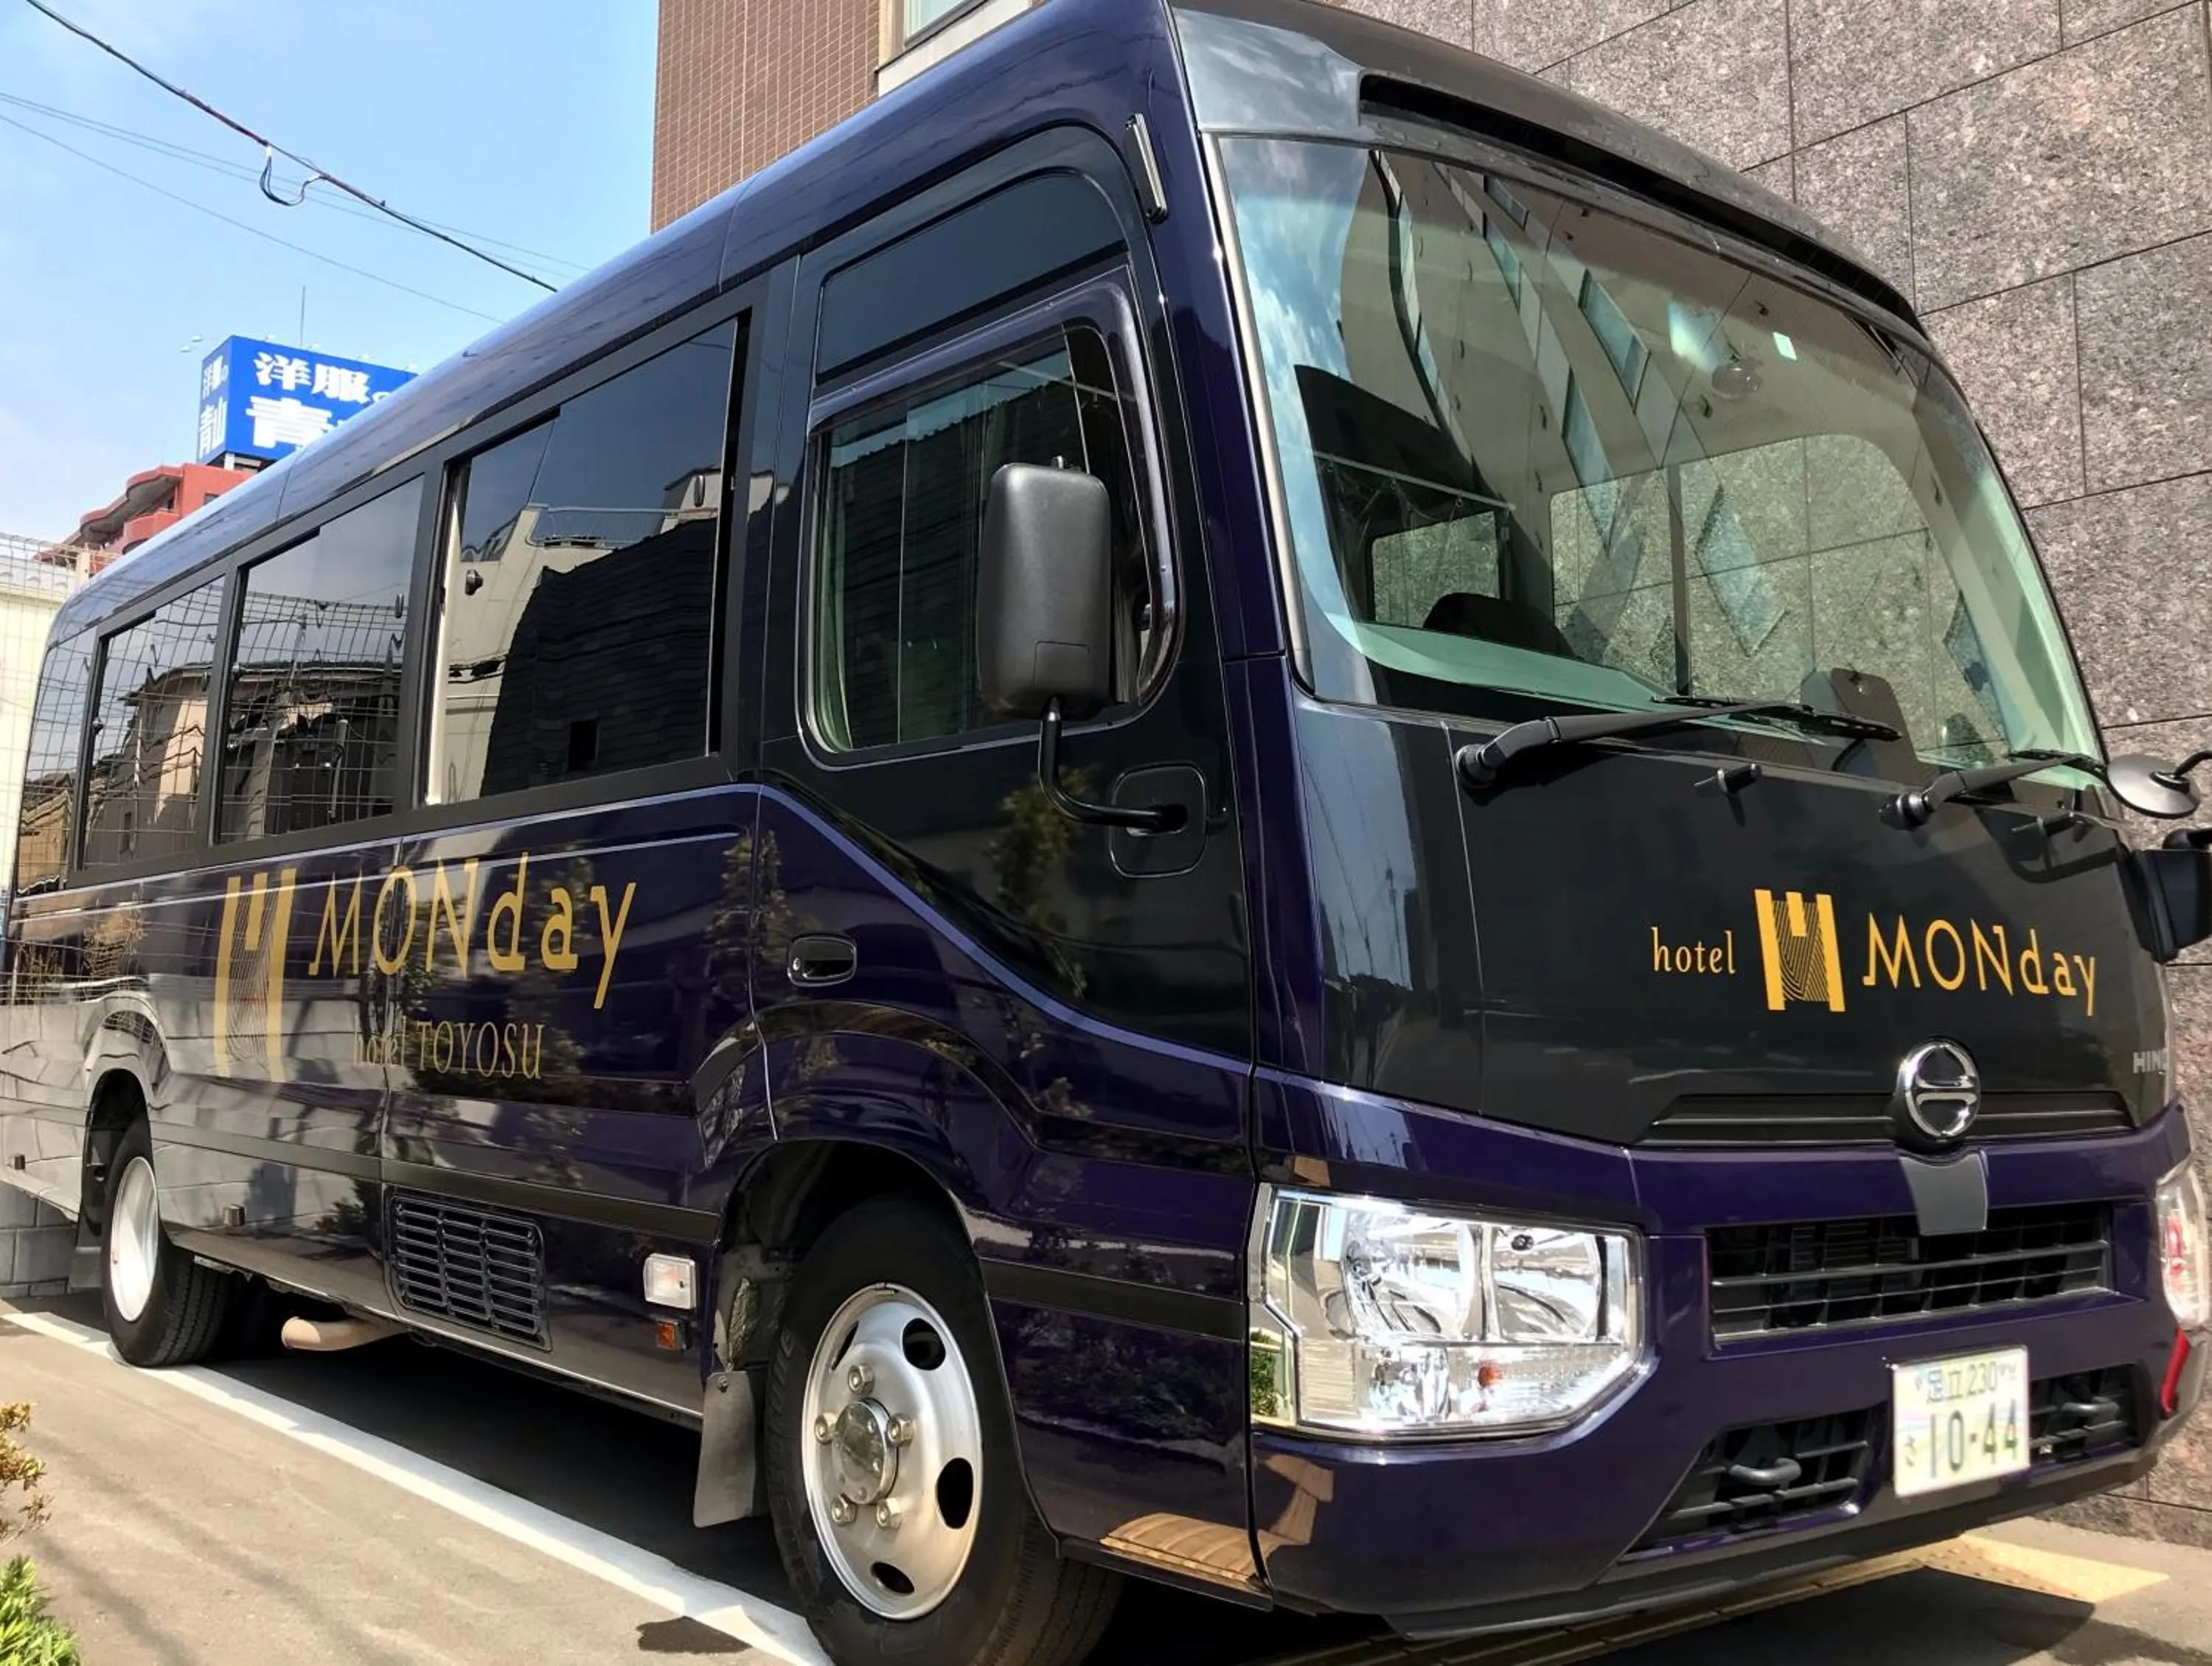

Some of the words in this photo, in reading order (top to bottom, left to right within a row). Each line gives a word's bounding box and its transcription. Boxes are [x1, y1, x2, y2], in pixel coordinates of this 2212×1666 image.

[246, 395, 348, 449] 青
[308, 851, 637, 1009] MONday
[1651, 927, 1736, 975] hotel
[1863, 913, 2097, 1017] MONday
[417, 1020, 545, 1080] TOYOSU
